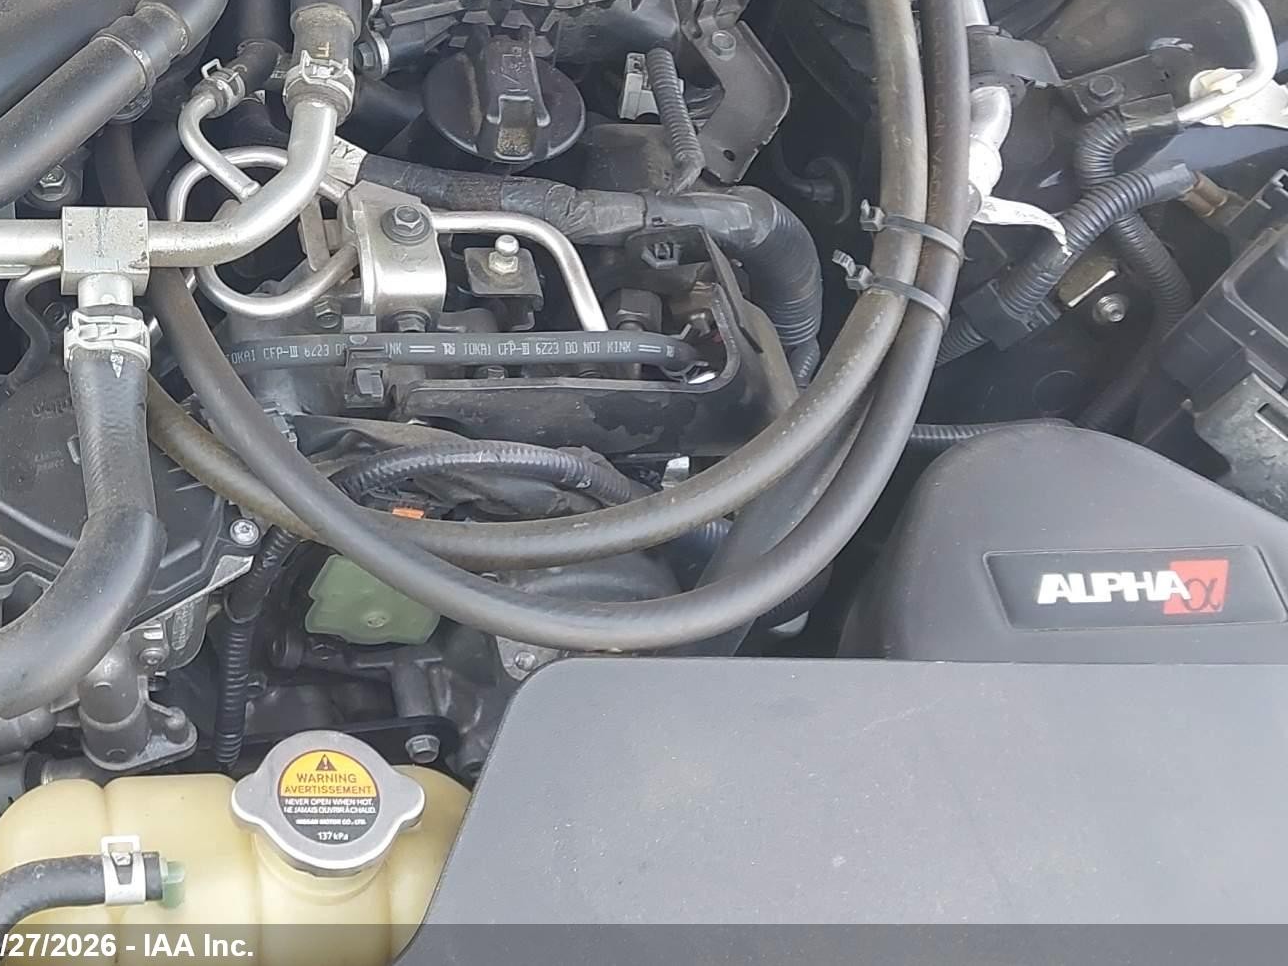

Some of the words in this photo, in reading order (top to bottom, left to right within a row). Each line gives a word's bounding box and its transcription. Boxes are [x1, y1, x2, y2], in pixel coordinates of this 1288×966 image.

[463, 342, 491, 355] TOKAI
[565, 341, 578, 354] DO
[583, 340, 601, 354] NOT
[607, 340, 631, 353] KINK
[1037, 570, 1191, 604] ALPHA
[297, 773, 357, 783] WARNING
[284, 786, 371, 794] AVERTISSEMENT
[285, 798, 309, 806] NEVER
[310, 798, 331, 806] OPEN
[332, 798, 356, 806] WHEN
[294, 806, 318, 814] JAMAIS
[317, 832, 332, 840] 137
